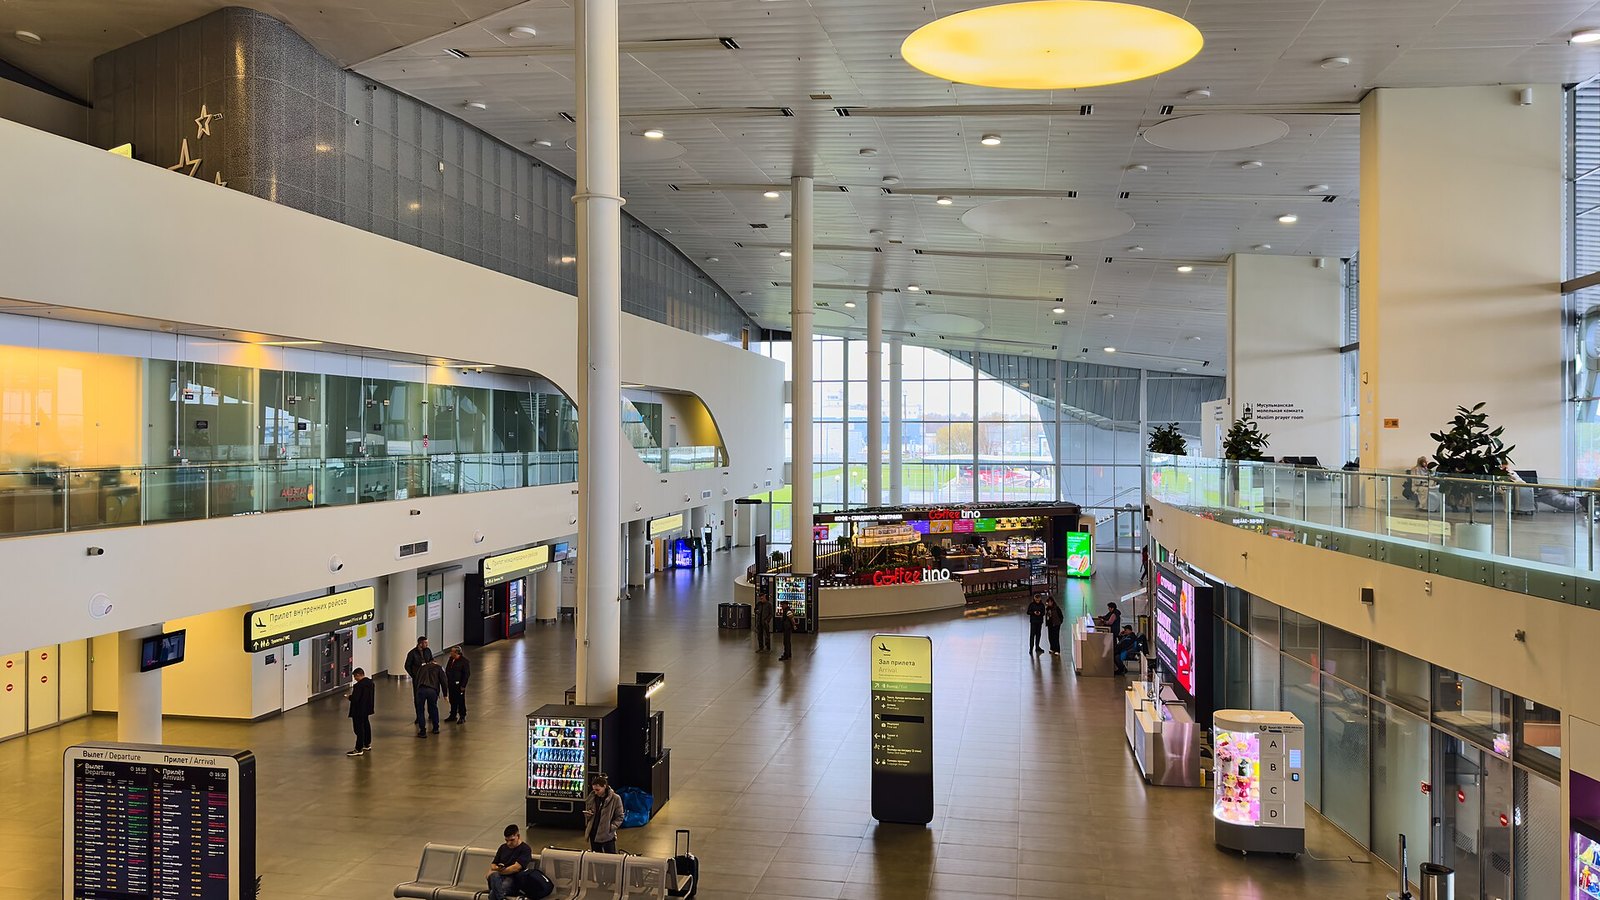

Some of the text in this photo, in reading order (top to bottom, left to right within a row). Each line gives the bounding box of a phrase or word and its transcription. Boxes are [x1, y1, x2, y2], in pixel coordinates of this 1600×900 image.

[269, 597, 348, 622] Прилет внутренних рейсов
[1269, 740, 1278, 749] A
[82, 750, 104, 758] Вылет
[109, 751, 141, 761] Departure
[164, 755, 188, 764] Прилет
[193, 757, 216, 765] Arrival
[84, 762, 104, 770] Вылет
[1270, 763, 1277, 772] B
[84, 769, 116, 777] Departures
[162, 768, 185, 776] Прилёт
[162, 774, 185, 782] Arrivals
[1270, 786, 1278, 795] C
[1270, 810, 1278, 818] D
